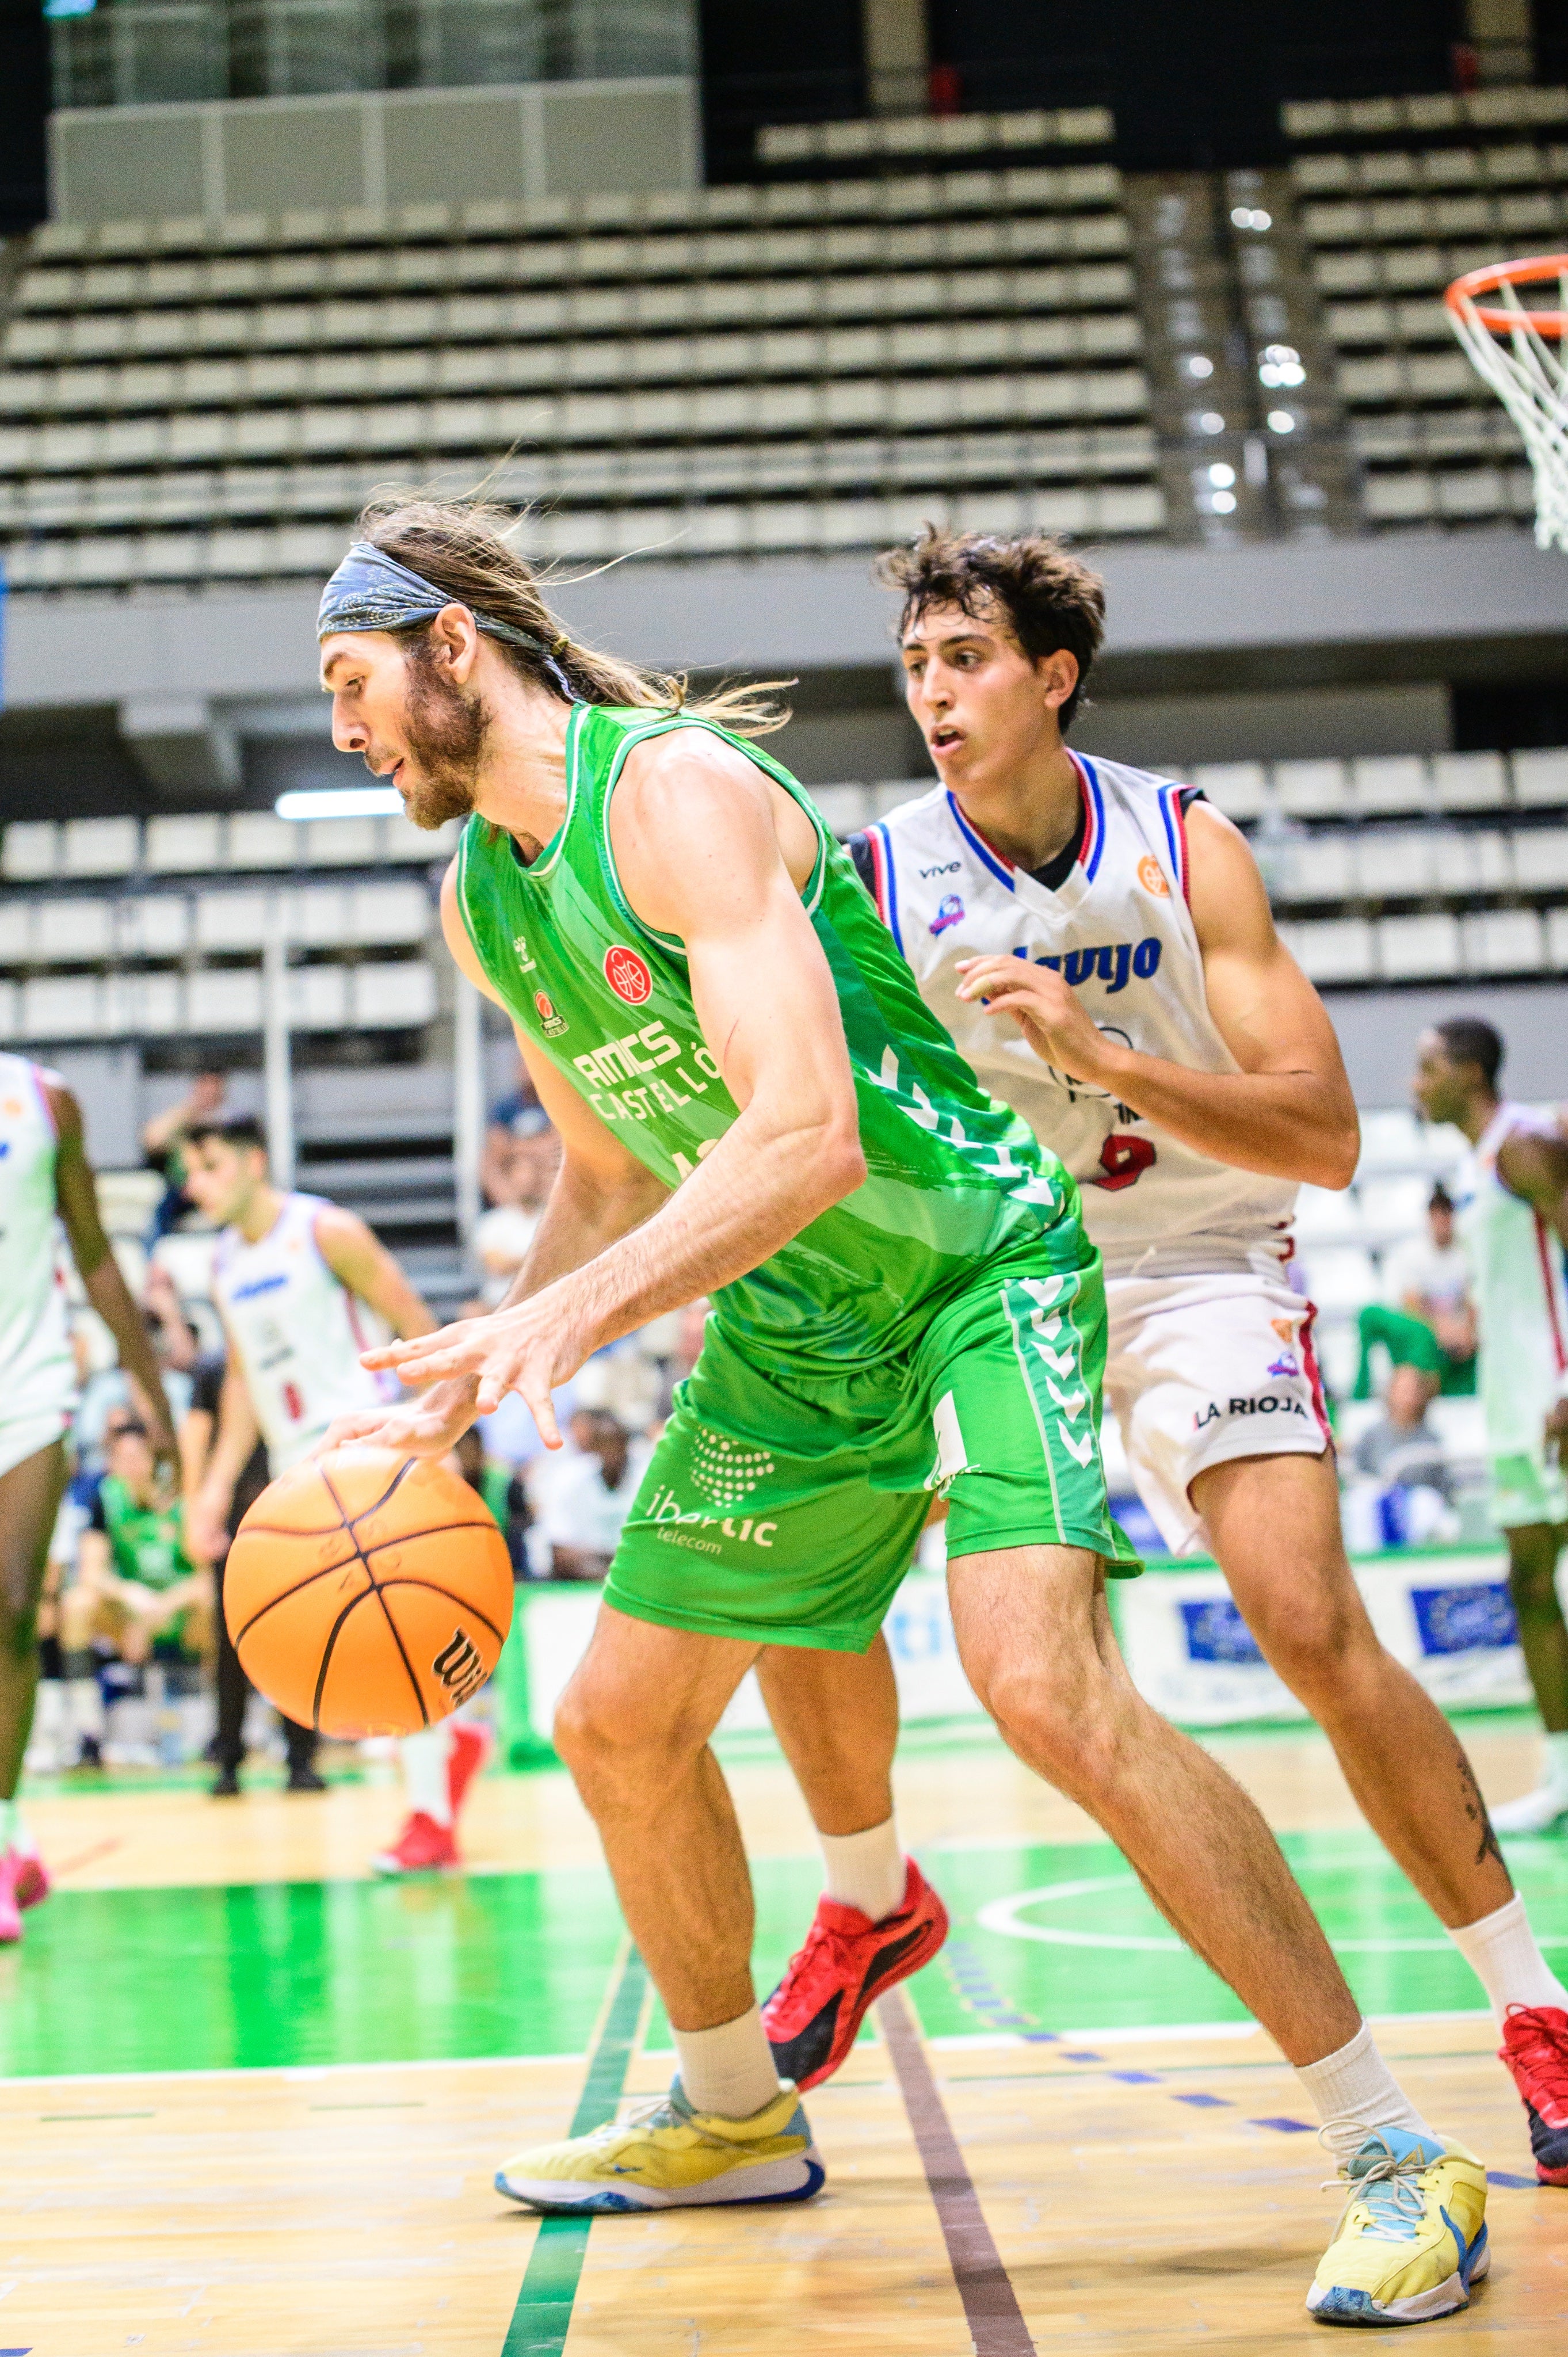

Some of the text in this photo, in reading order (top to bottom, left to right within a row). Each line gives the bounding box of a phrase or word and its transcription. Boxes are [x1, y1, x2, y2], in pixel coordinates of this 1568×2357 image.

[919, 861, 961, 879] vive
[1196, 1395, 1308, 1429] LA RIOJA
[657, 1525, 722, 1555] telecom
